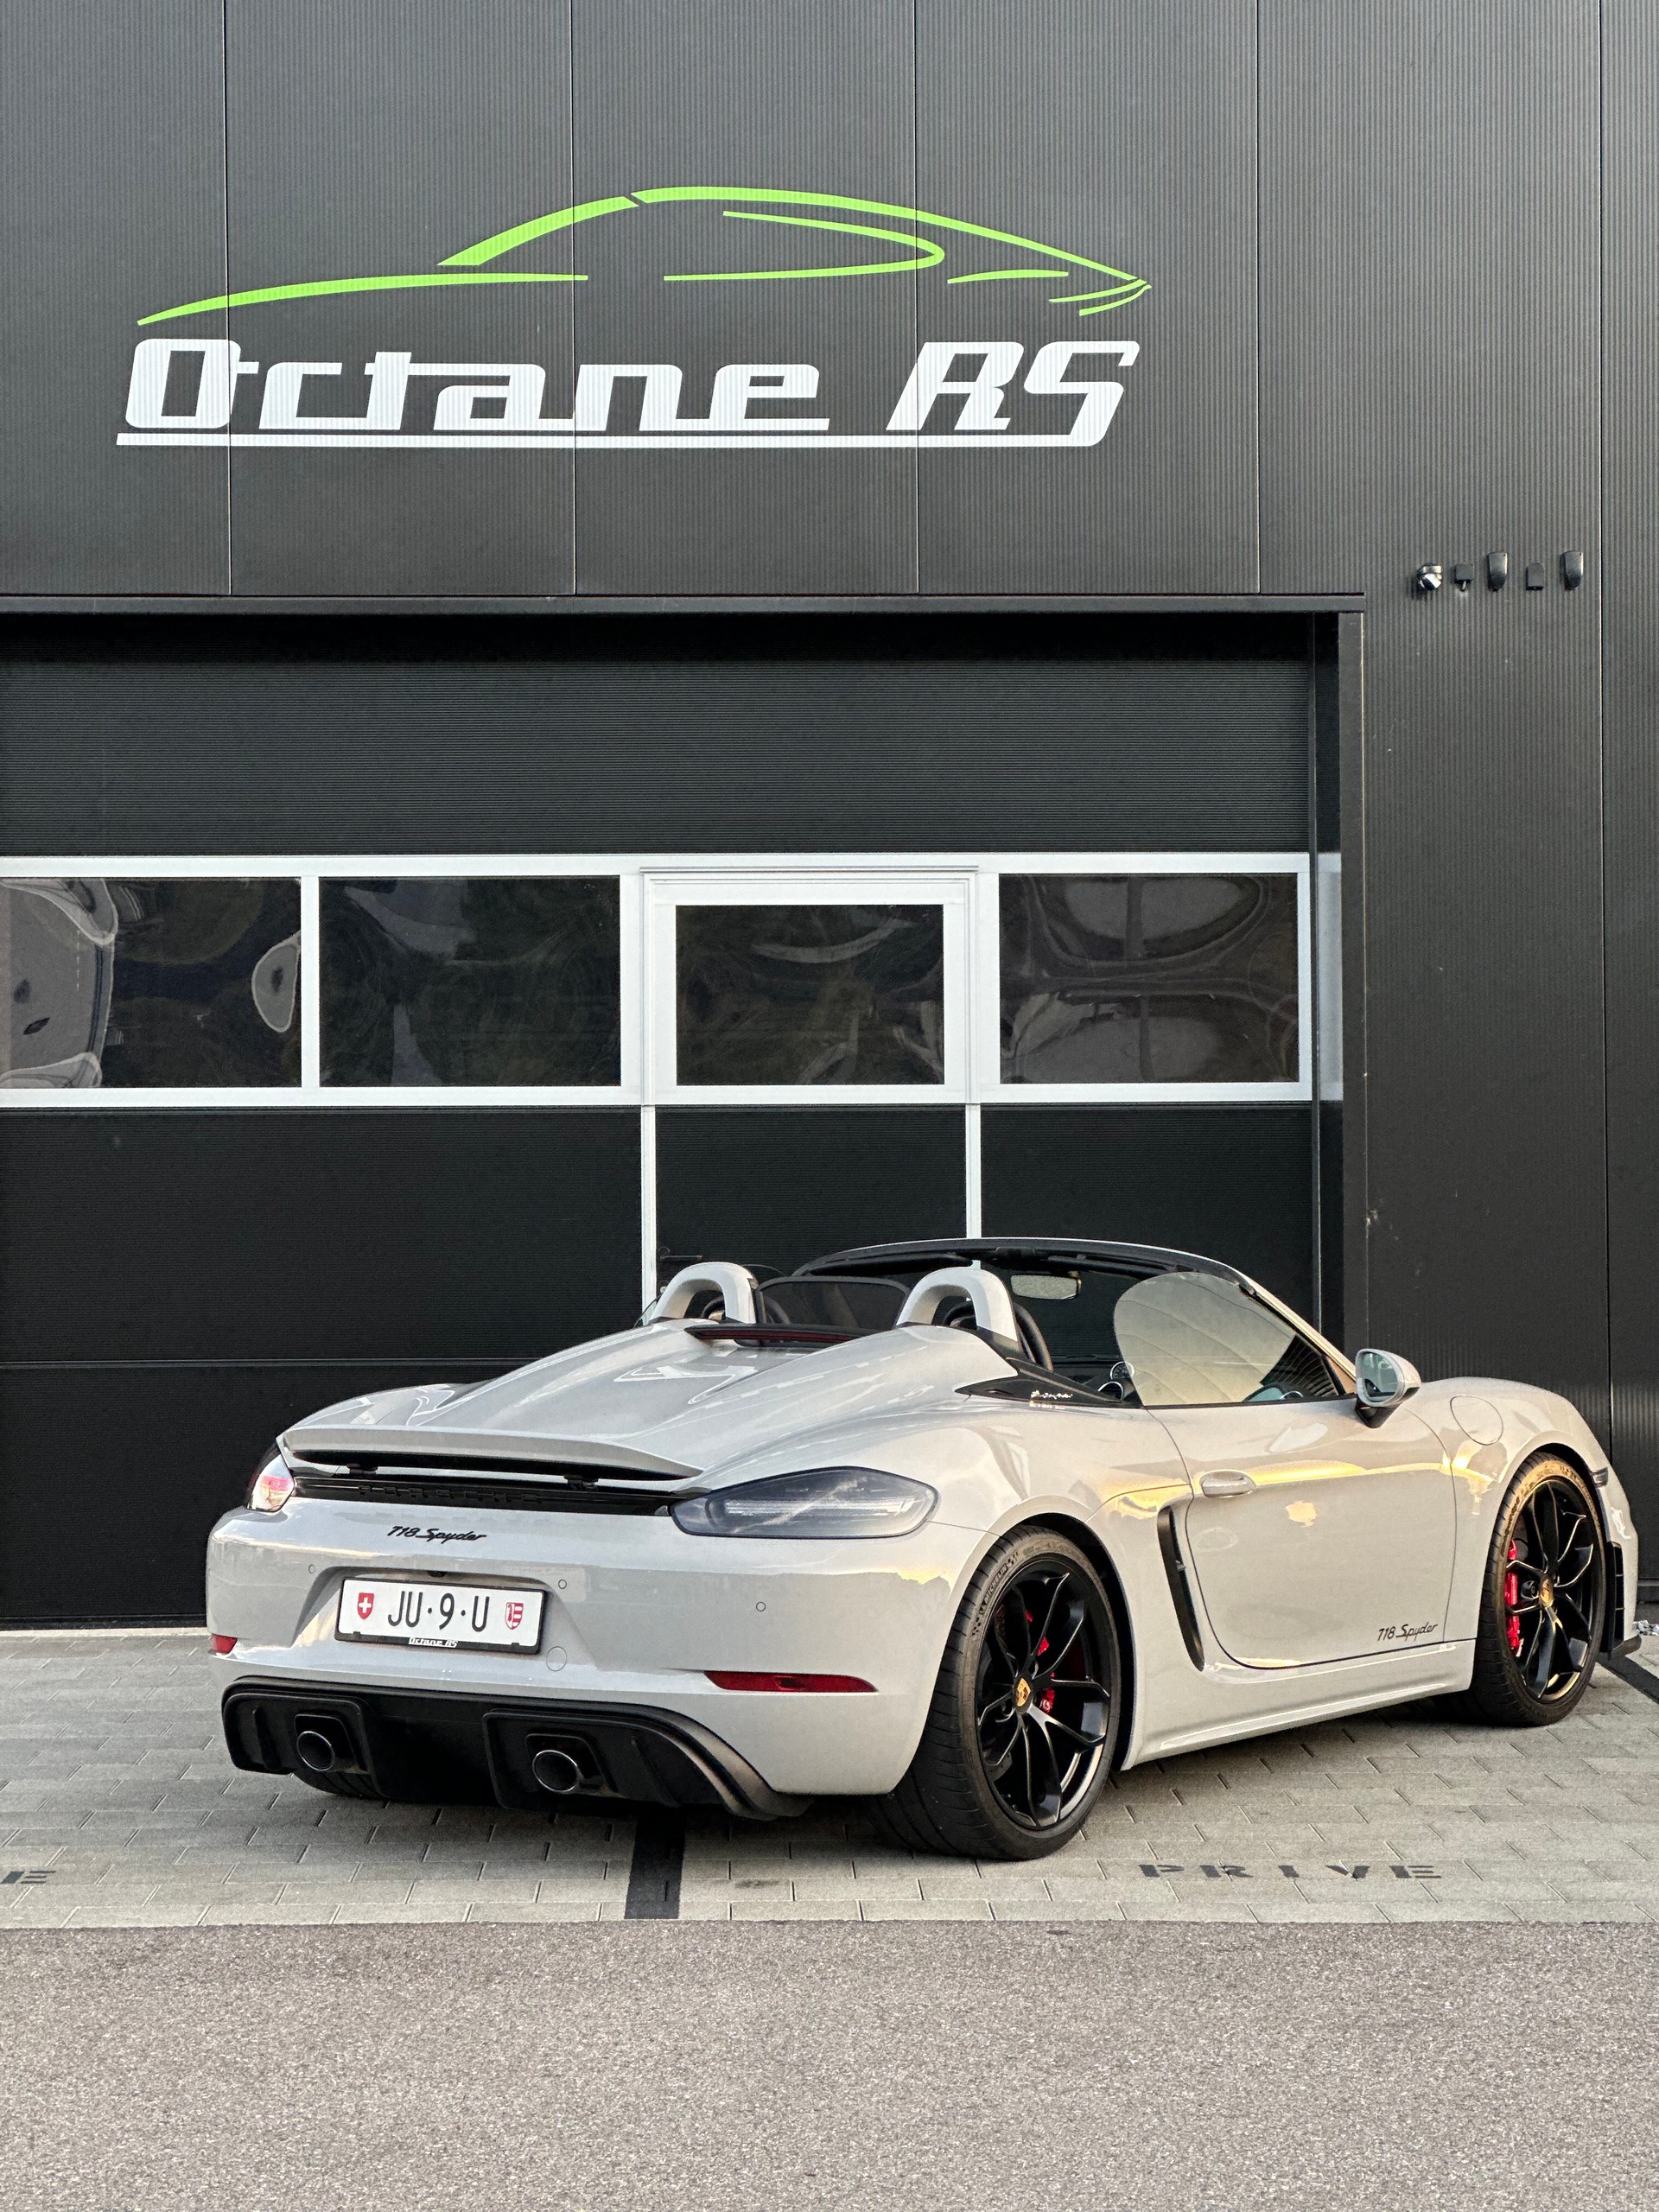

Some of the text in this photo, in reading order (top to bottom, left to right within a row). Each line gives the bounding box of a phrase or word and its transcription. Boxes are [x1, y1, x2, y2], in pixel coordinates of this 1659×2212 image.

[125, 338, 1141, 448] Octane RS
[387, 1526, 486, 1544] 718 Spyder
[1377, 1622, 1438, 1642] 718 Spyder
[409, 1637, 443, 1646] Octane
[1138, 1864, 1442, 1879] PRIVE
